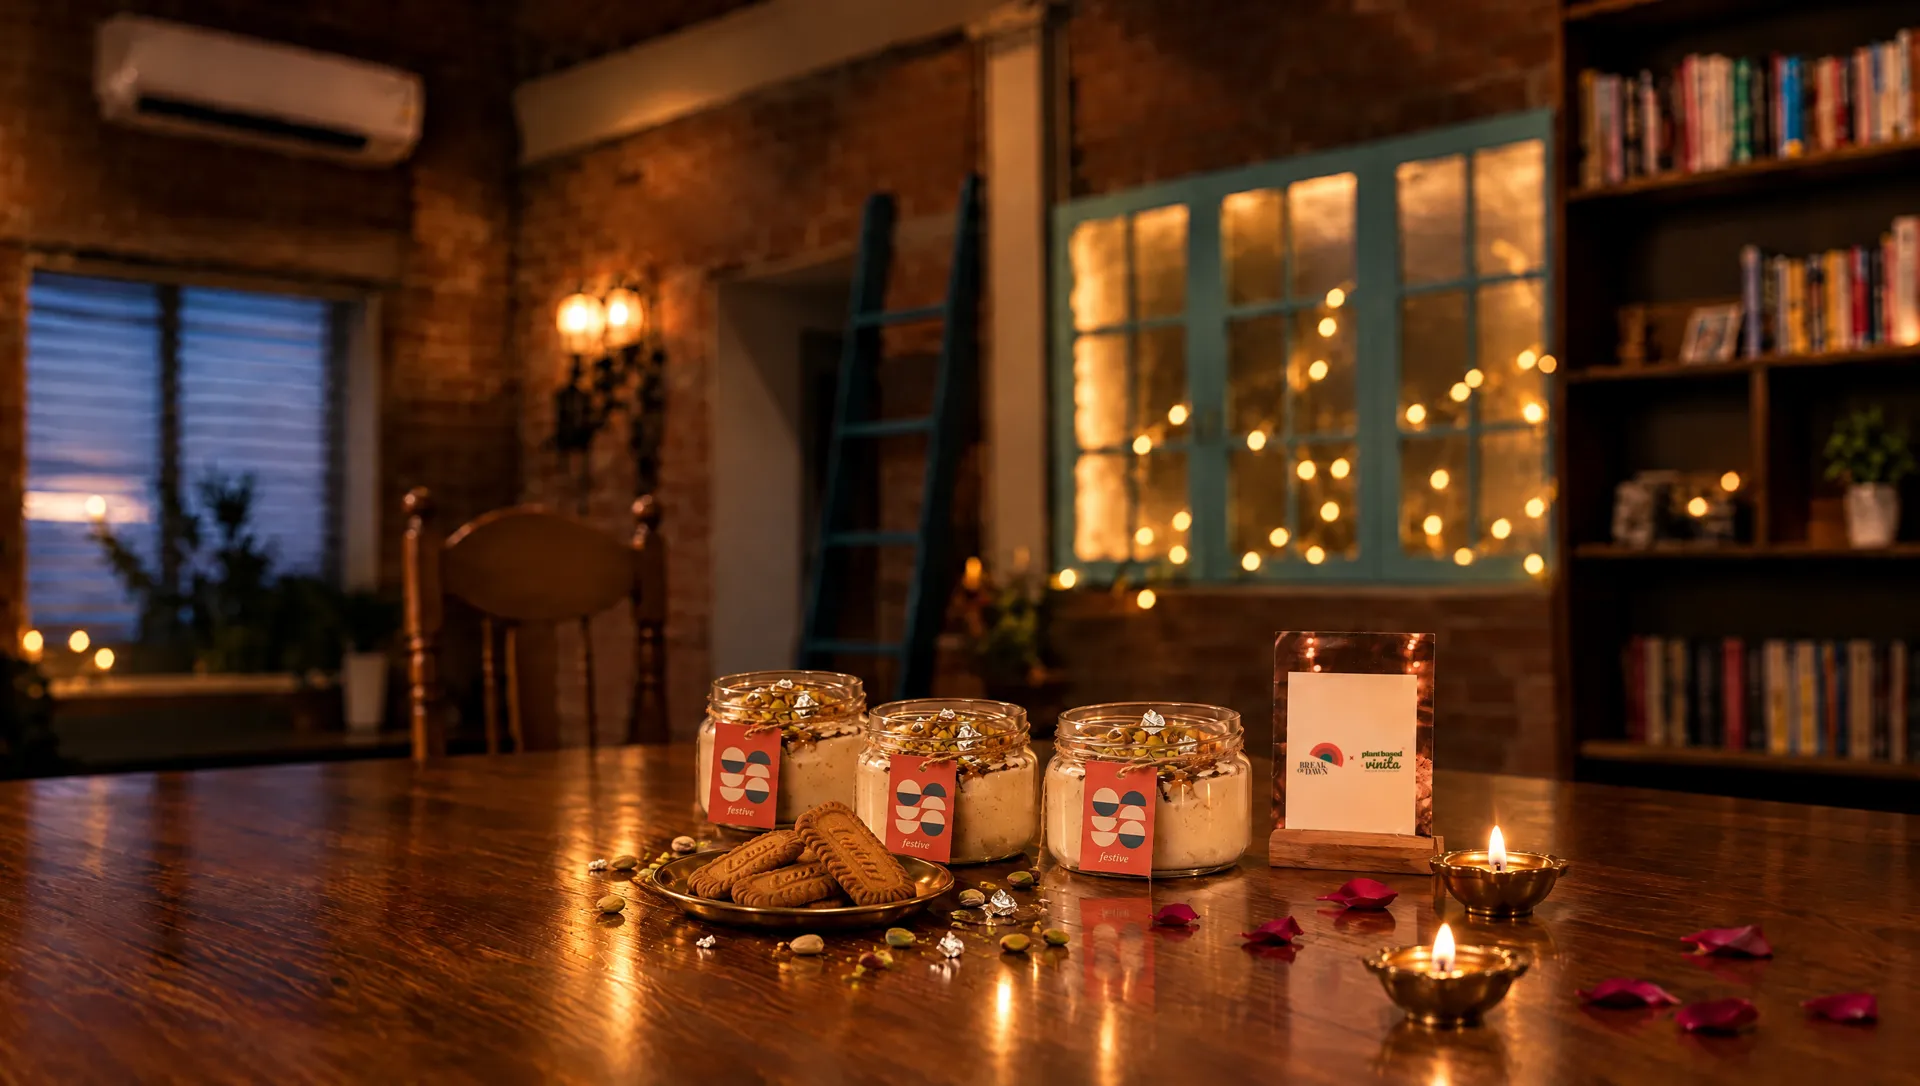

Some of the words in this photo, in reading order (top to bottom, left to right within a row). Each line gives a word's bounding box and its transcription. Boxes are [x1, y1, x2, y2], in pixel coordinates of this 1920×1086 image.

[1299, 761, 1327, 769] BREAK
[1365, 756, 1401, 769] vinita
[726, 805, 755, 816] festive
[901, 838, 930, 849] festive
[1098, 851, 1129, 863] festive
